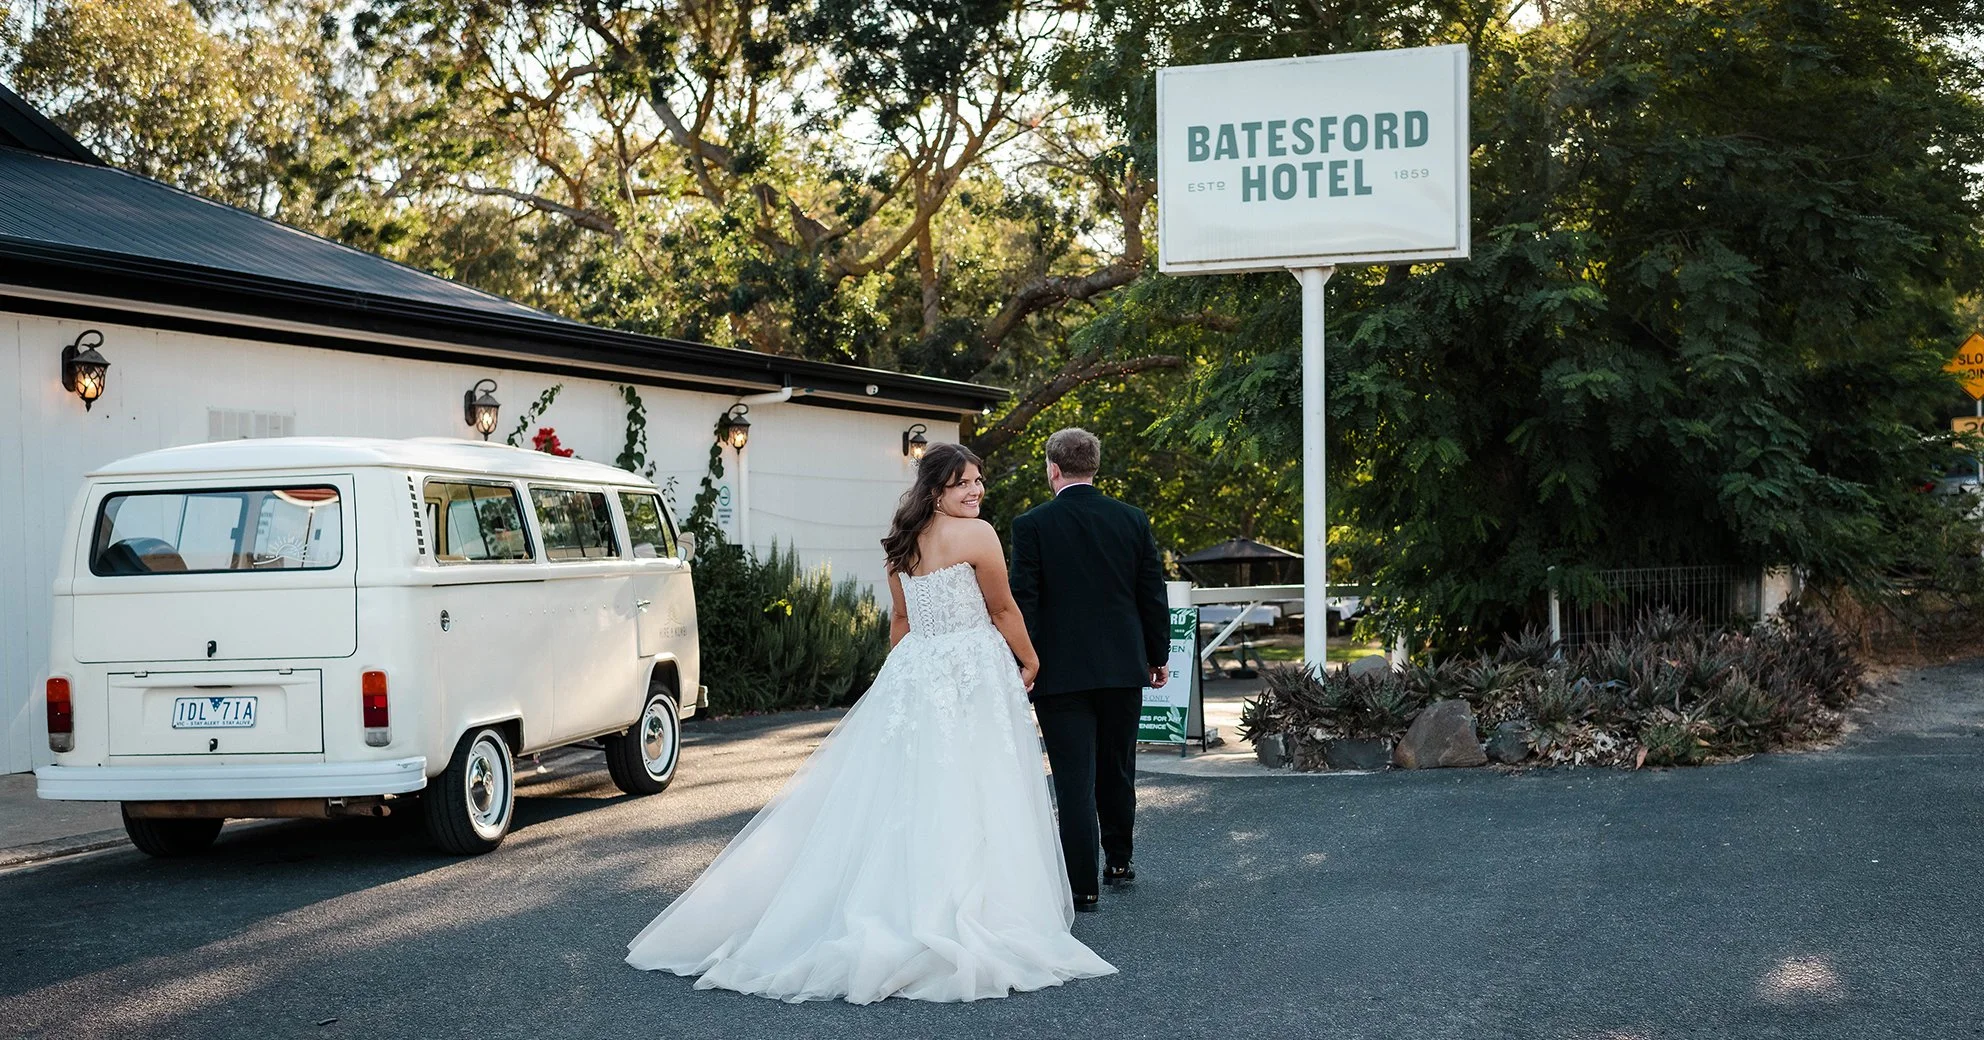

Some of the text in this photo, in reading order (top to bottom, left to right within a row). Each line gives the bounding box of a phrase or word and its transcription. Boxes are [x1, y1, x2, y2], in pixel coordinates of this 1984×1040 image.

[1187, 110, 1429, 163] BATESFORD
[1241, 158, 1373, 203] HOTEL
[1394, 168, 1430, 180] 1859
[1170, 645, 1186, 653] EN
[179, 701, 252, 721] 1DL 7IA
